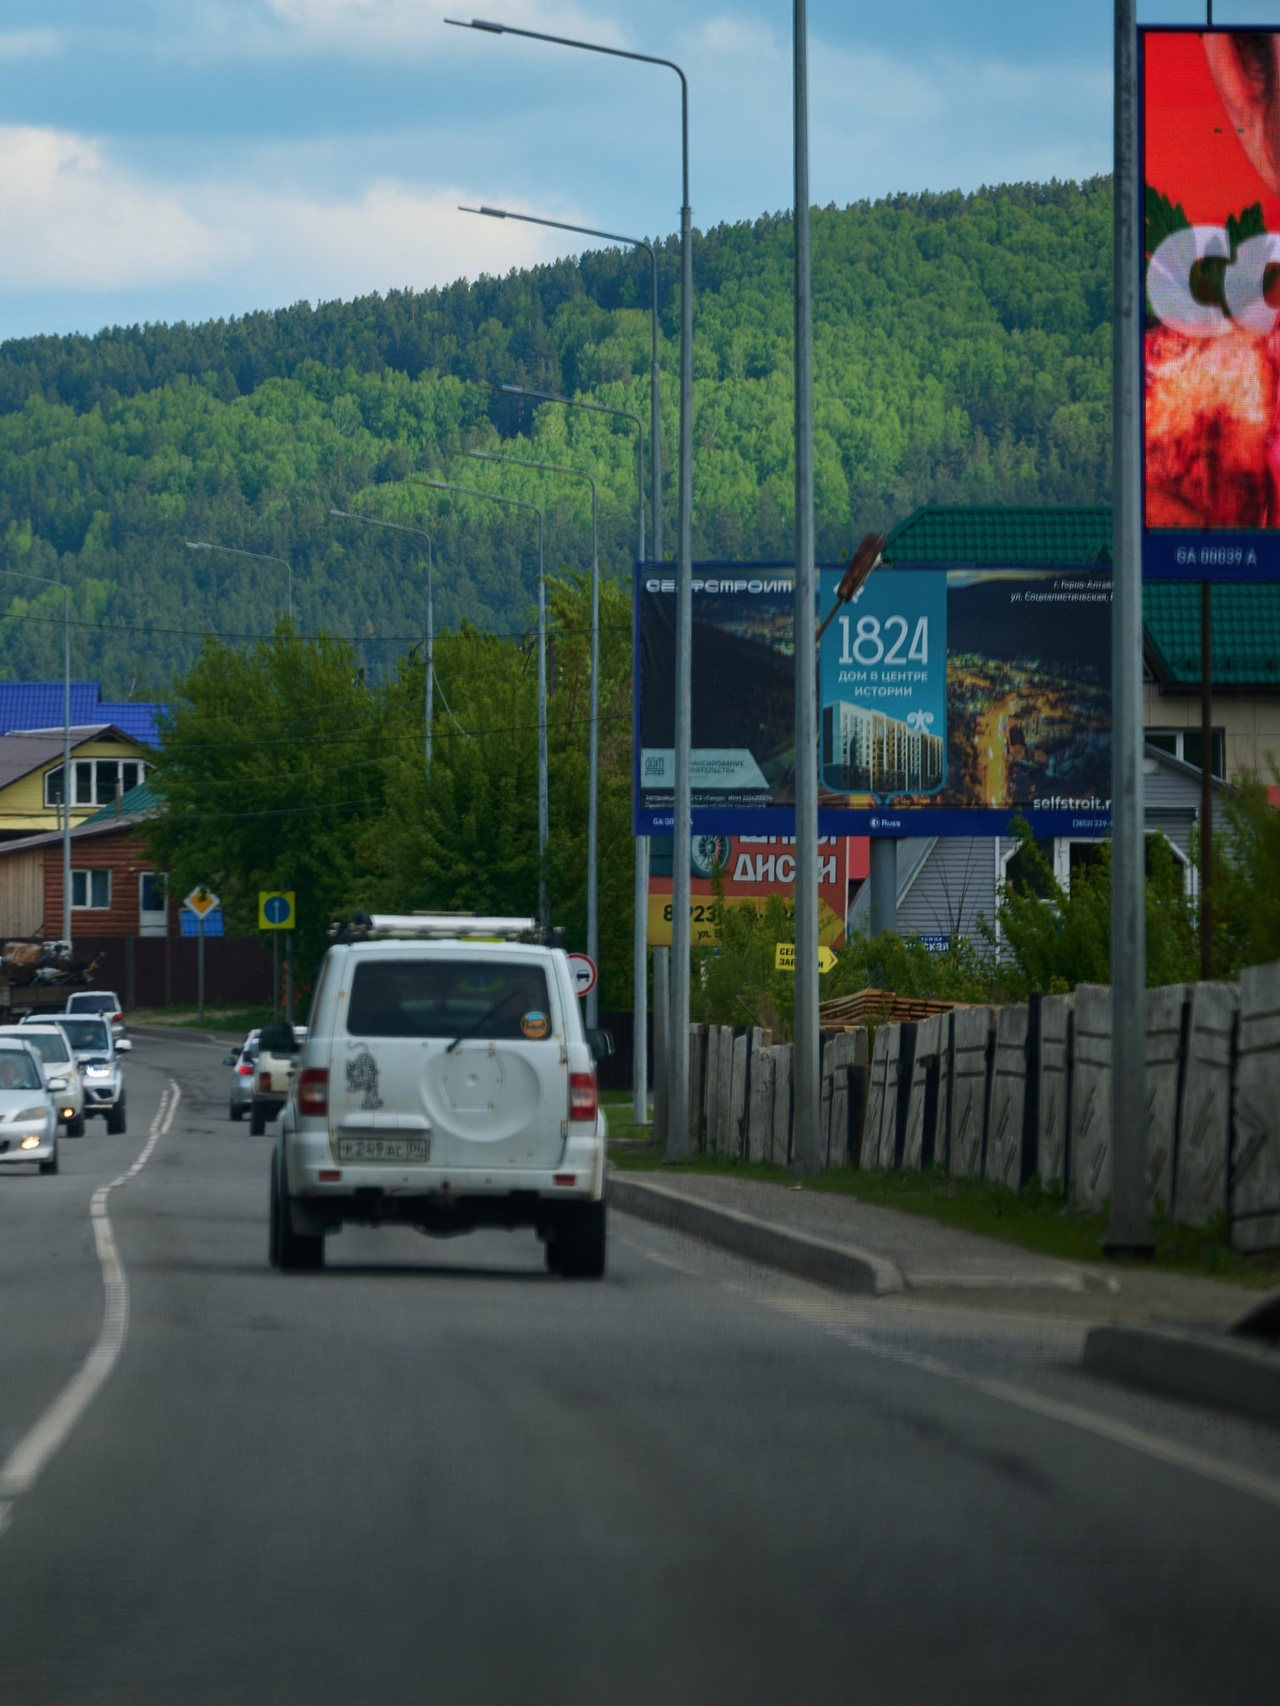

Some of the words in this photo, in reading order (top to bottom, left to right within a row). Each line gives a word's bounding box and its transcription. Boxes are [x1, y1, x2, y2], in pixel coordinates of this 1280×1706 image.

[838, 614, 929, 666] 1824
[838, 671, 867, 683] ДОМ
[870, 671, 879, 682] В
[881, 671, 928, 683] ЦЕНТРЕ
[854, 686, 913, 697] ИСТОРИИ
[1033, 796, 1112, 810] selfstroit.r
[732, 853, 837, 884] ДИСИ
